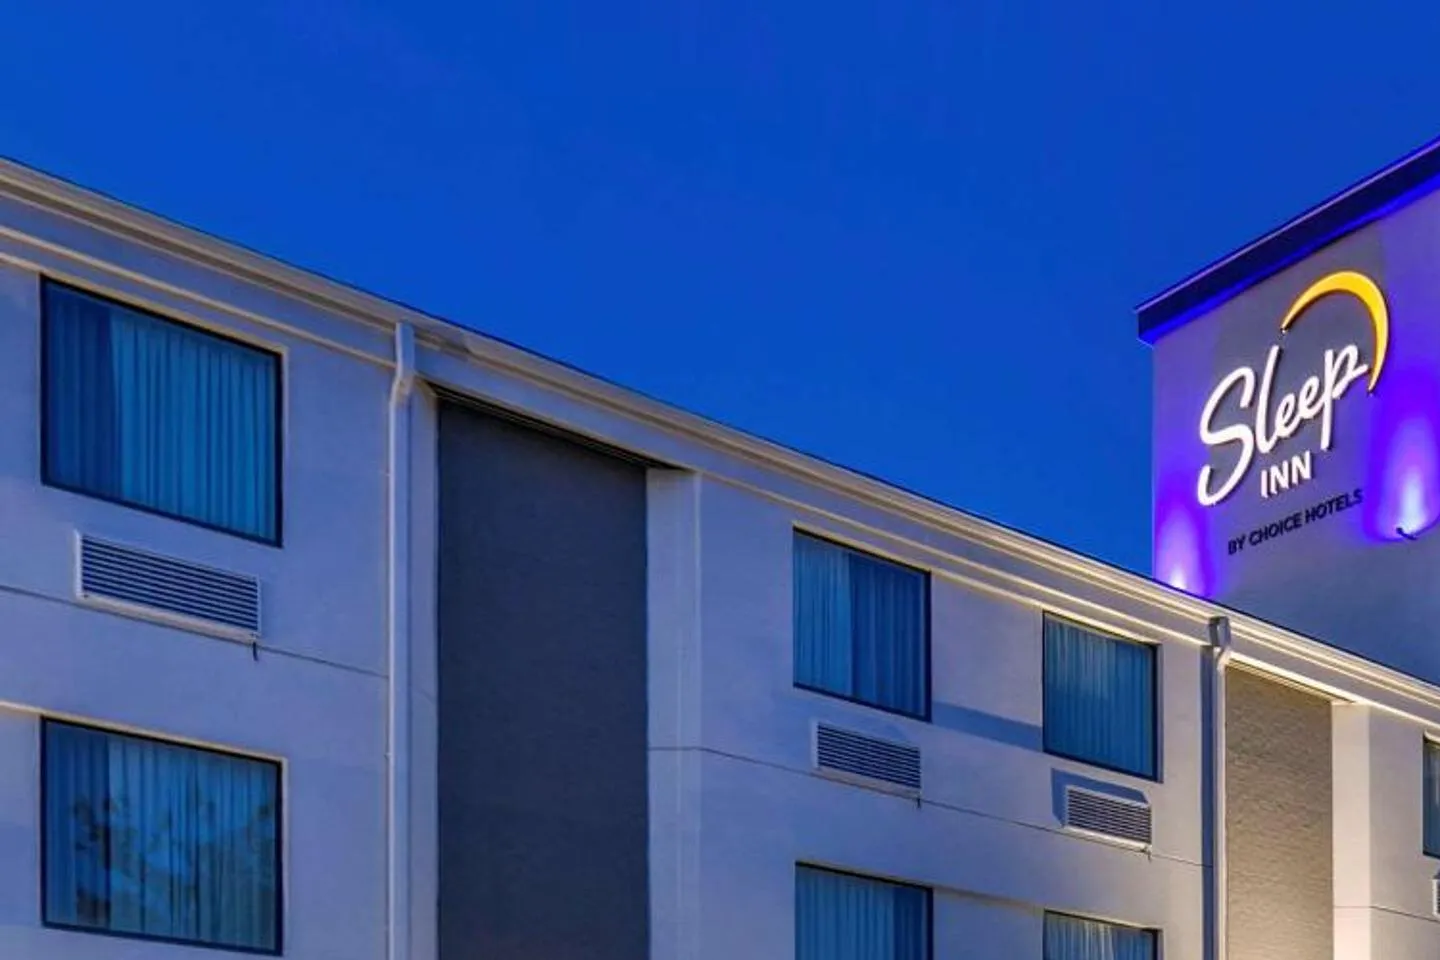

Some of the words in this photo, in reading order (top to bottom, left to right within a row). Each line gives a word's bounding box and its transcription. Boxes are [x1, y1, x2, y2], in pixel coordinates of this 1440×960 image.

[1197, 344, 1370, 506] Sleep
[1260, 451, 1312, 498] INN
[1228, 534, 1246, 555] BY
[1249, 511, 1302, 546] CHOICE
[1305, 488, 1363, 524] HOTELS
